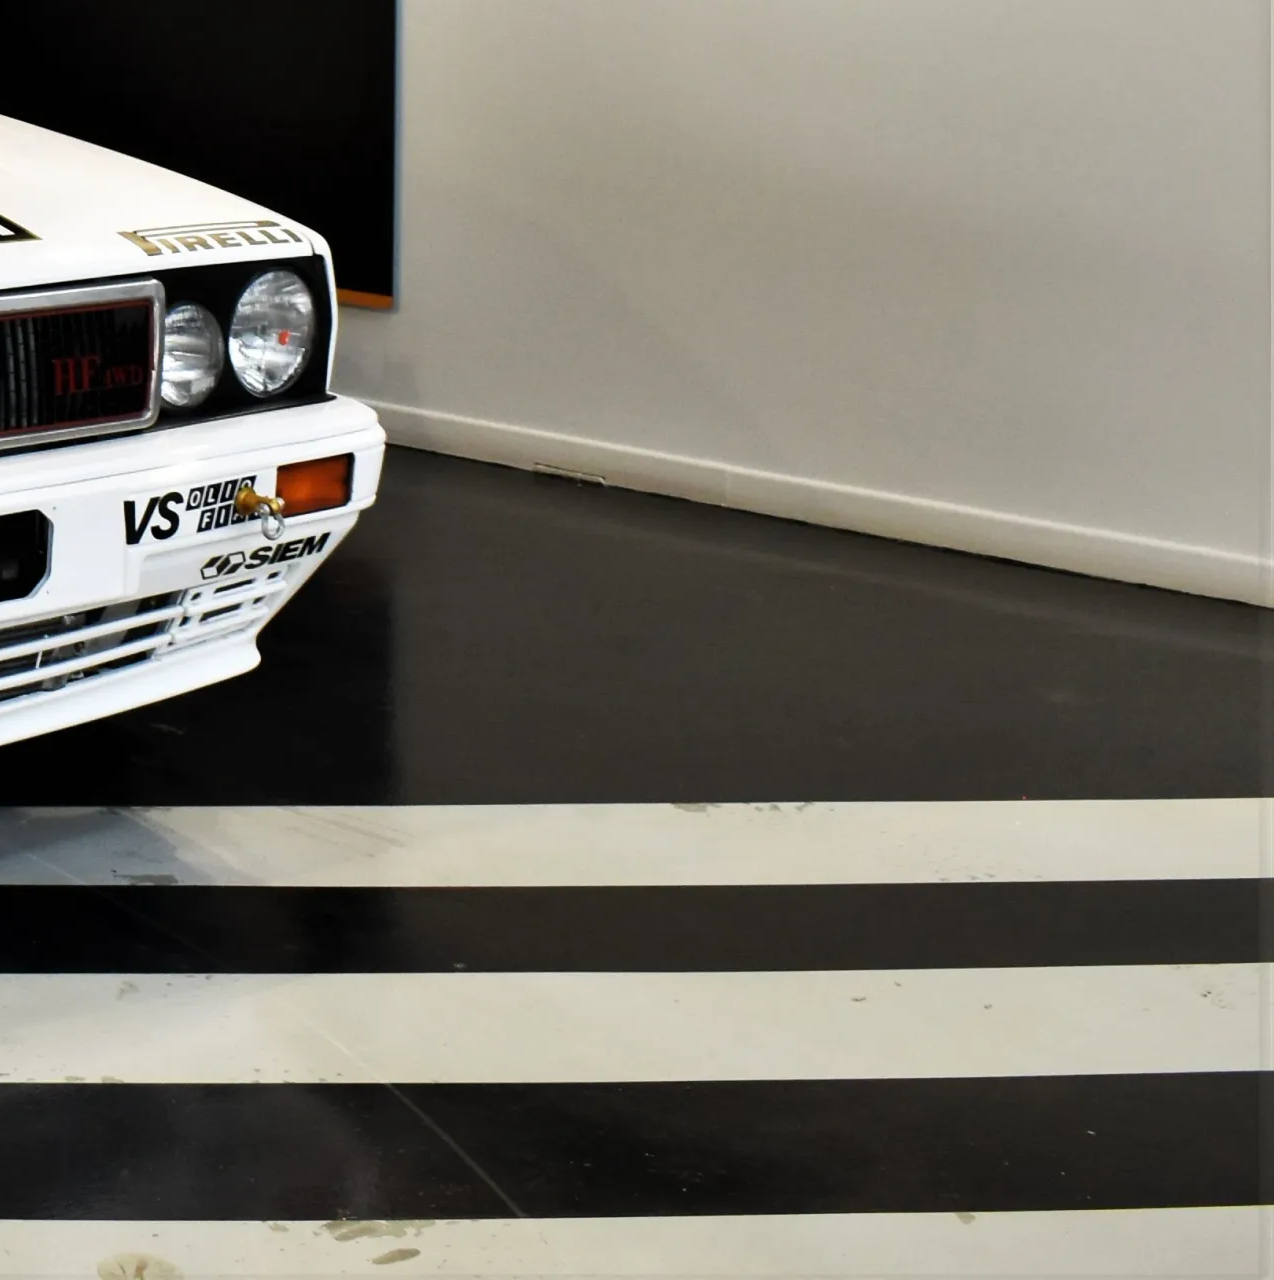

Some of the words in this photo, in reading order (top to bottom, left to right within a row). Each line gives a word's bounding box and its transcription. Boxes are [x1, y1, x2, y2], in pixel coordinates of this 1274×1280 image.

[117, 220, 303, 256] PIRELLI
[52, 355, 101, 396] HF
[124, 492, 184, 545] VS
[200, 508, 261, 530] FI
[244, 532, 331, 569] SIEM
